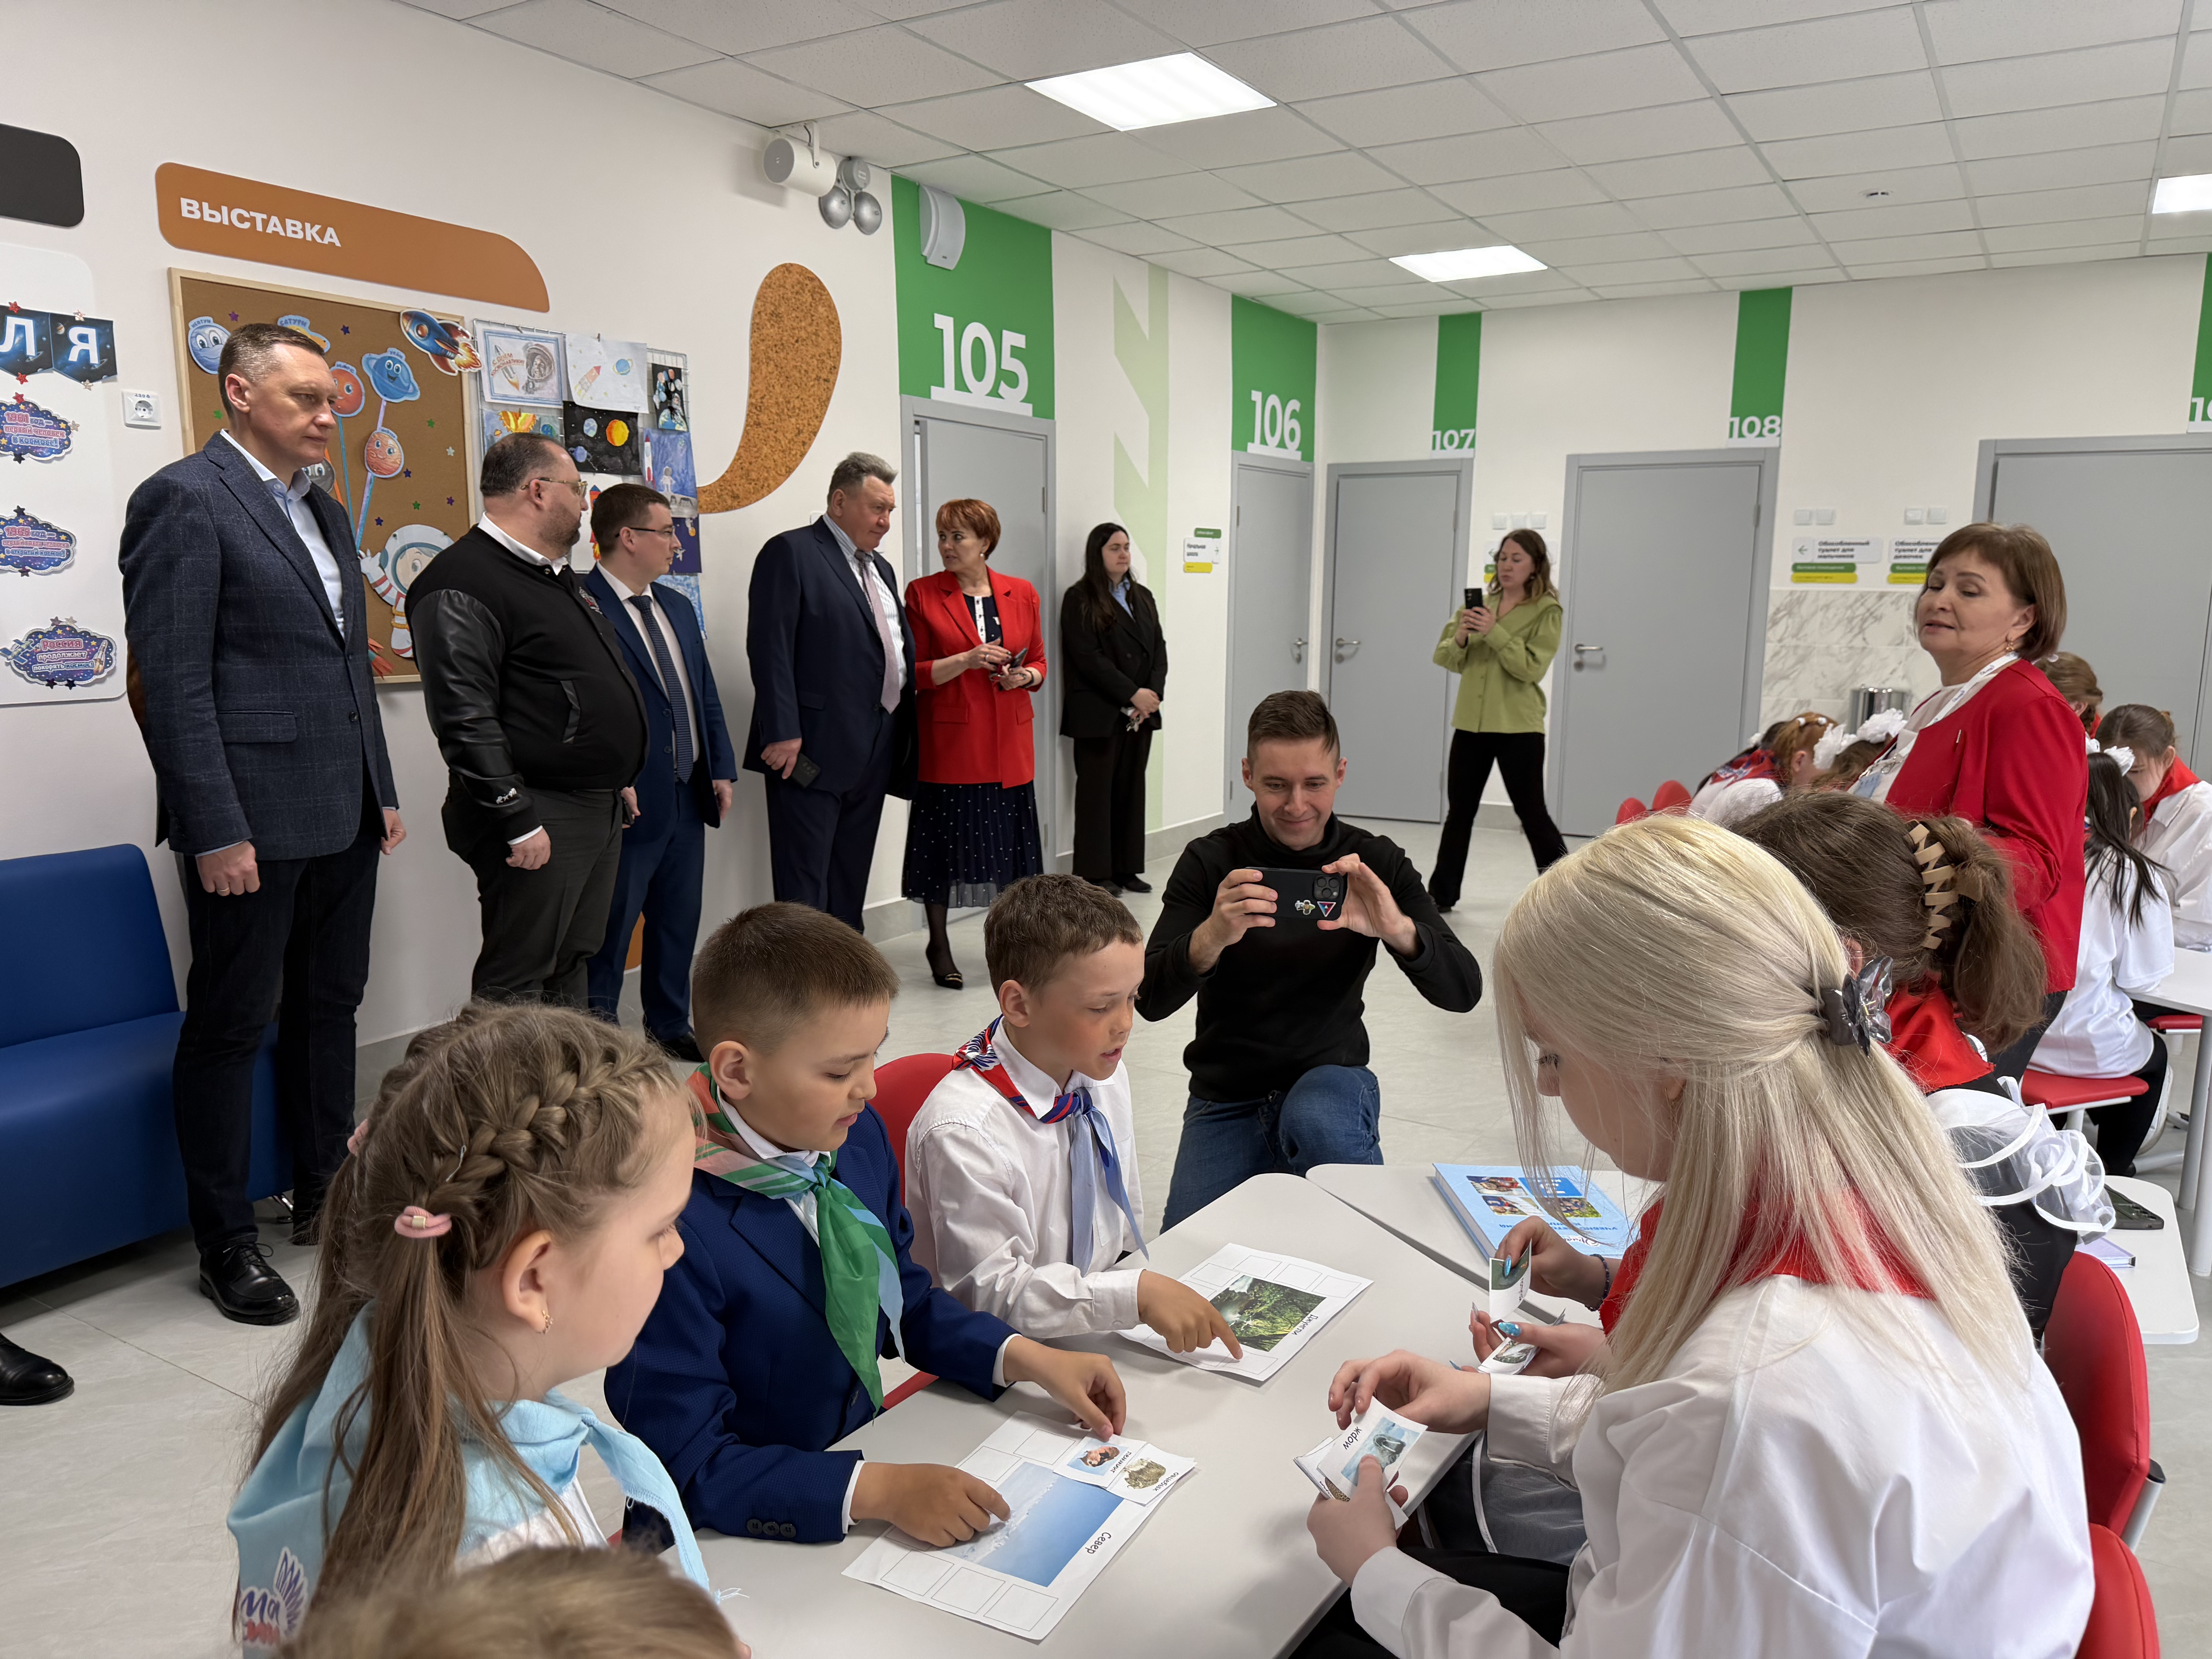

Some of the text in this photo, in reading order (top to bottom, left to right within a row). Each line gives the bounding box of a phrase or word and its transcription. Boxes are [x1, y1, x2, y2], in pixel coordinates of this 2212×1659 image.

[180, 197, 341, 247] ВЫСТАВКА
[934, 313, 1029, 404] 105
[5, 412, 29, 423] 1961
[1251, 390, 1301, 451] 106
[1729, 415, 1781, 439] 108
[5, 426, 65, 437] первый человек
[19, 437, 58, 447] космосе!
[1432, 428, 1475, 451] 107
[5, 527, 30, 537] 1965
[42, 639, 82, 650] Россия
[38, 651, 86, 661] продолжает
[34, 664, 65, 672] покорять
[1292, 1314, 1319, 1335] Джунгли
[1343, 1426, 1362, 1450] морж
[1152, 1471, 1179, 1492] овцебык
[1085, 1531, 1112, 1556] Север
